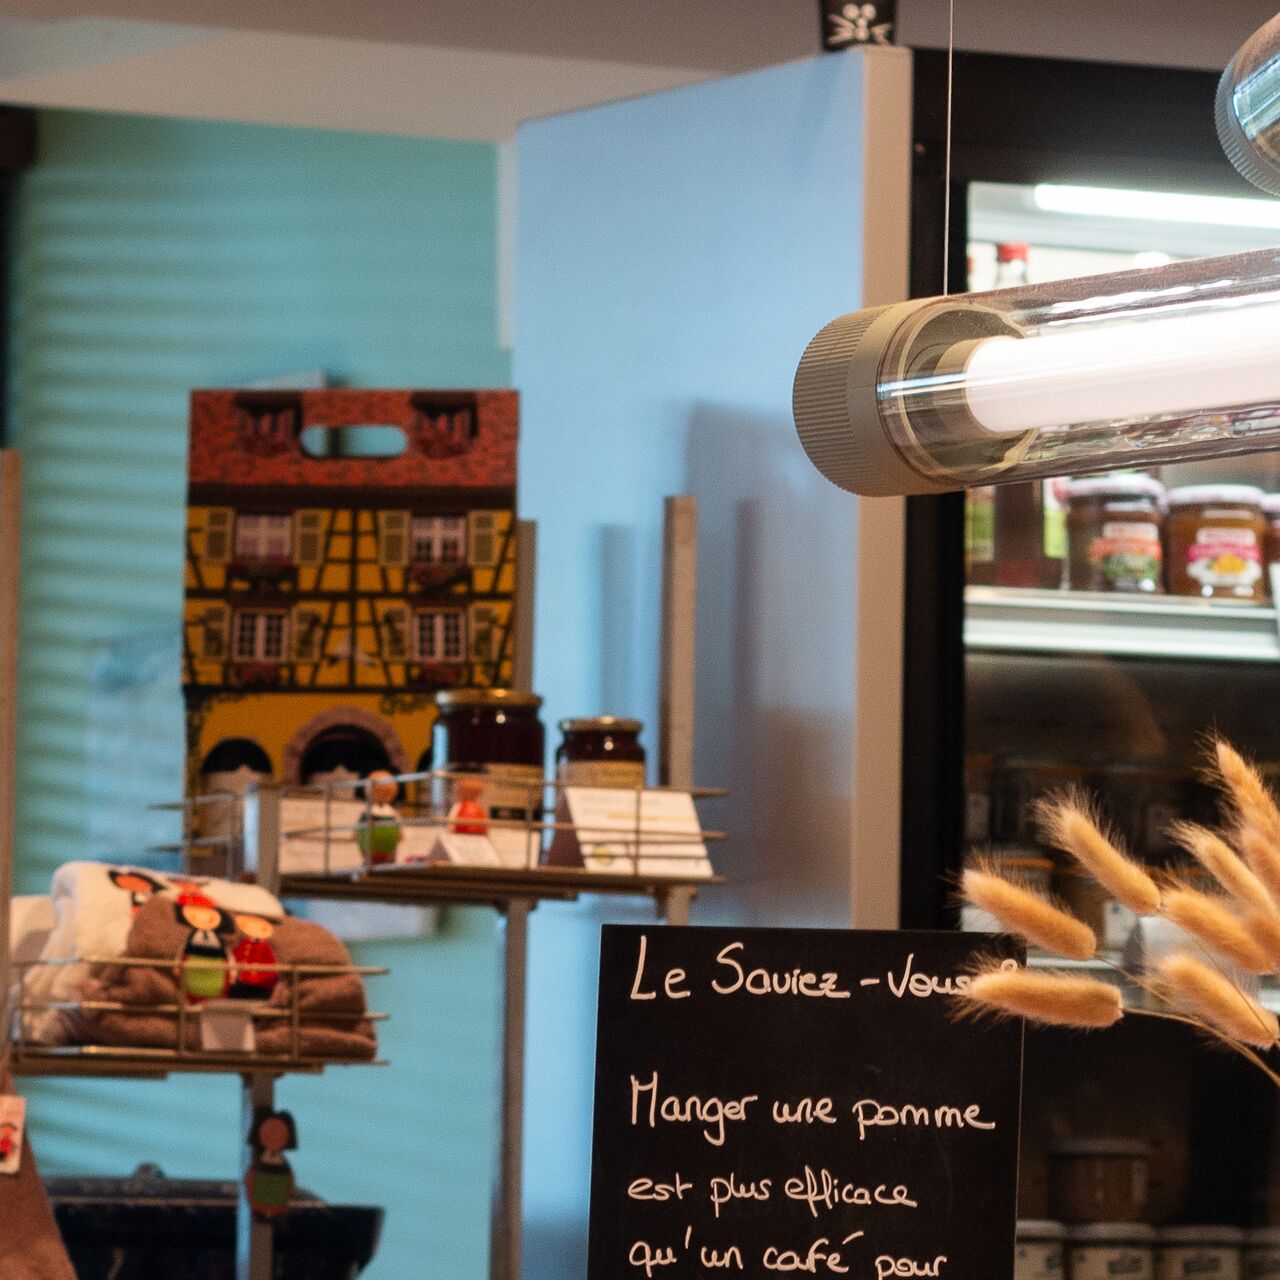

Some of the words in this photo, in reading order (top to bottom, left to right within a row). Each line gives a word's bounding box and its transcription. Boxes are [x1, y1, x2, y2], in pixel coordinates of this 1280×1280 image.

[630, 935, 691, 1000] Le
[630, 1071, 759, 1146] Manger
[772, 1097, 837, 1124] une
[852, 1099, 996, 1140] pomme
[627, 1172, 693, 1201] est
[710, 1172, 772, 1218] plus
[784, 1165, 918, 1218] efficace
[762, 1230, 865, 1274] café
